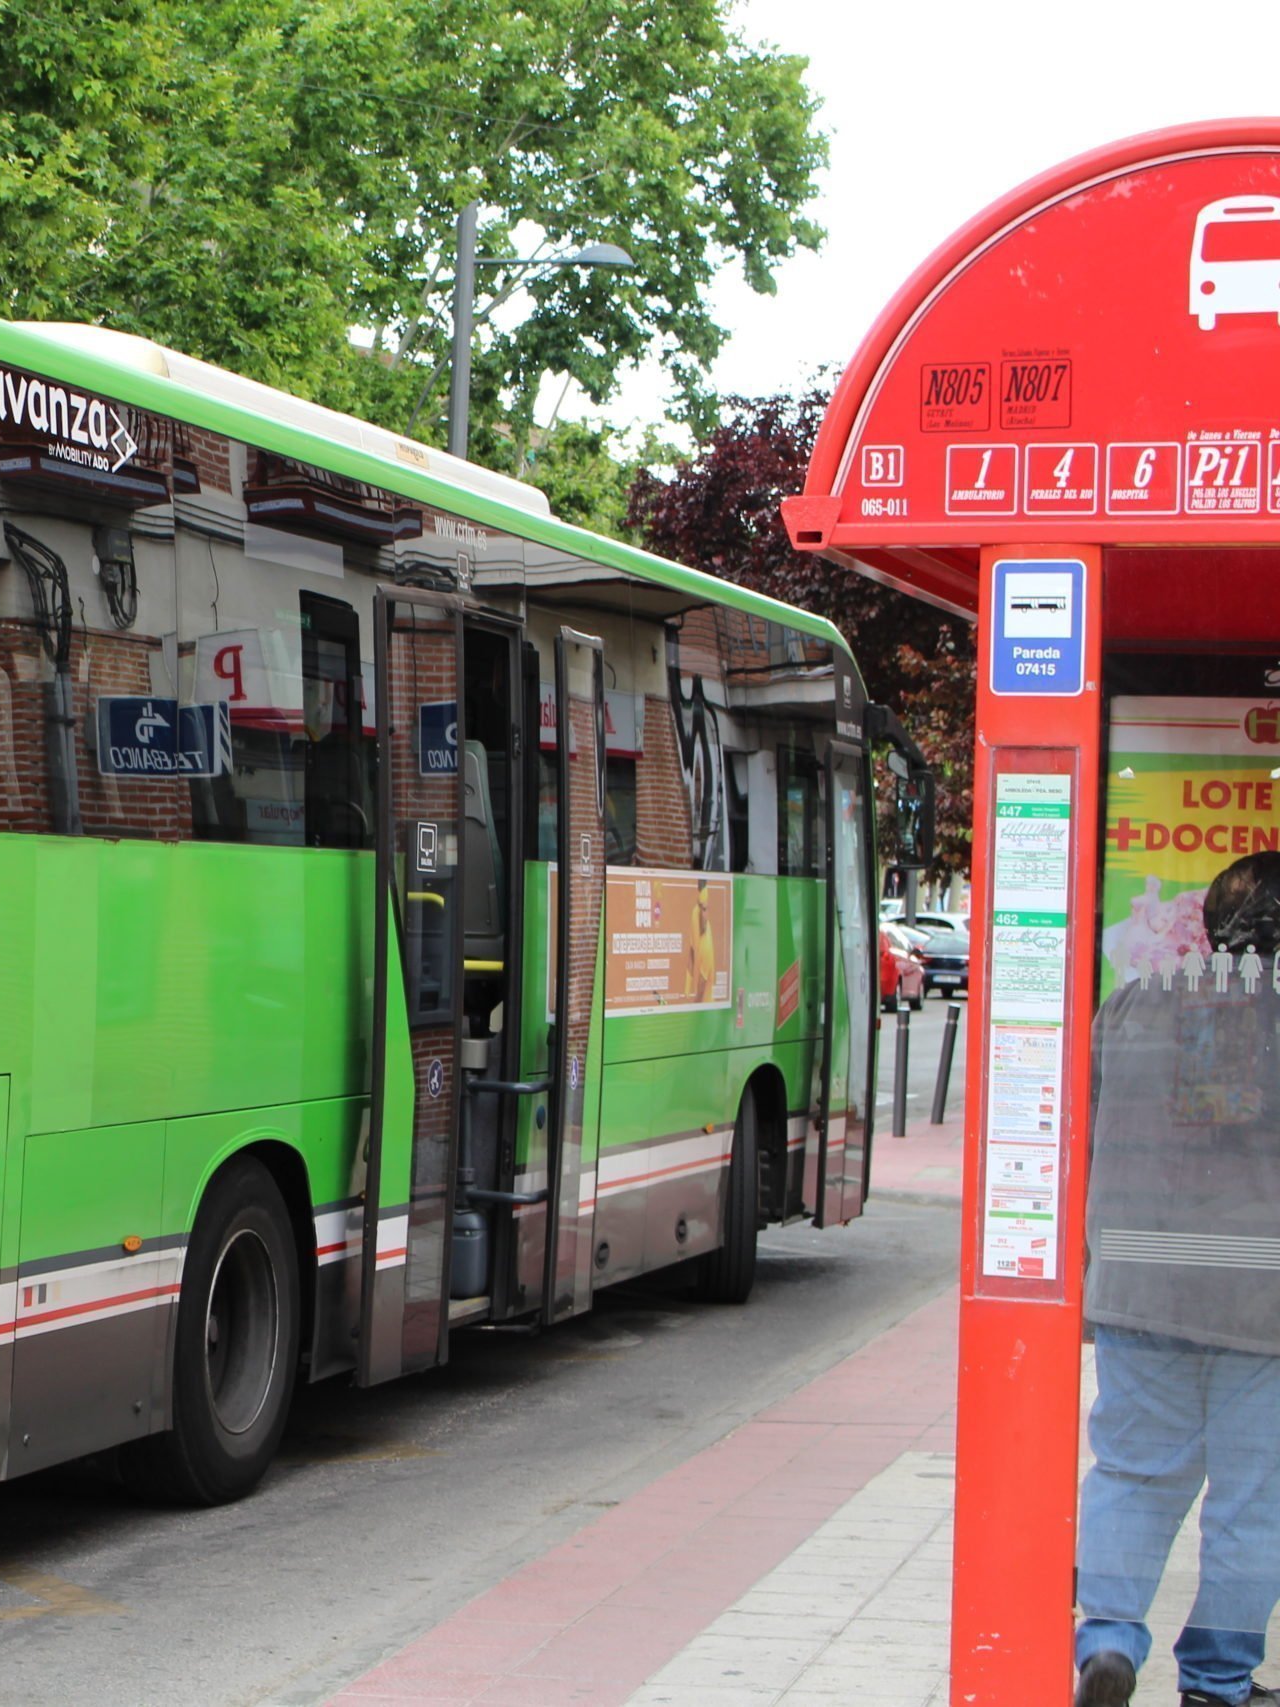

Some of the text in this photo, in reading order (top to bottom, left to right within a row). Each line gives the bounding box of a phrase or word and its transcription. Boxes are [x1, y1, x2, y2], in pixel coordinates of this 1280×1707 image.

[924, 368, 985, 406] N805
[1003, 364, 1067, 402] N807
[1199, 430, 1222, 440] Lunes
[1233, 429, 1261, 440] Viernes
[48, 442, 109, 472] BY MOBILITY ADO
[974, 449, 992, 488] 1
[1053, 448, 1074, 488] 4
[1133, 447, 1157, 488] 6
[951, 489, 1006, 501] AMBULATORIO
[1030, 489, 1093, 500] PERALES DEL RIO
[1111, 489, 1149, 500] HOSPITAL
[861, 498, 908, 516] 065-011
[434, 514, 487, 550] www.crtm.es
[1013, 646, 1061, 659] Parada
[1016, 663, 1056, 676] 07415
[1182, 779, 1273, 811] LOTE
[999, 805, 1023, 818] 447
[996, 913, 1019, 925] 462
